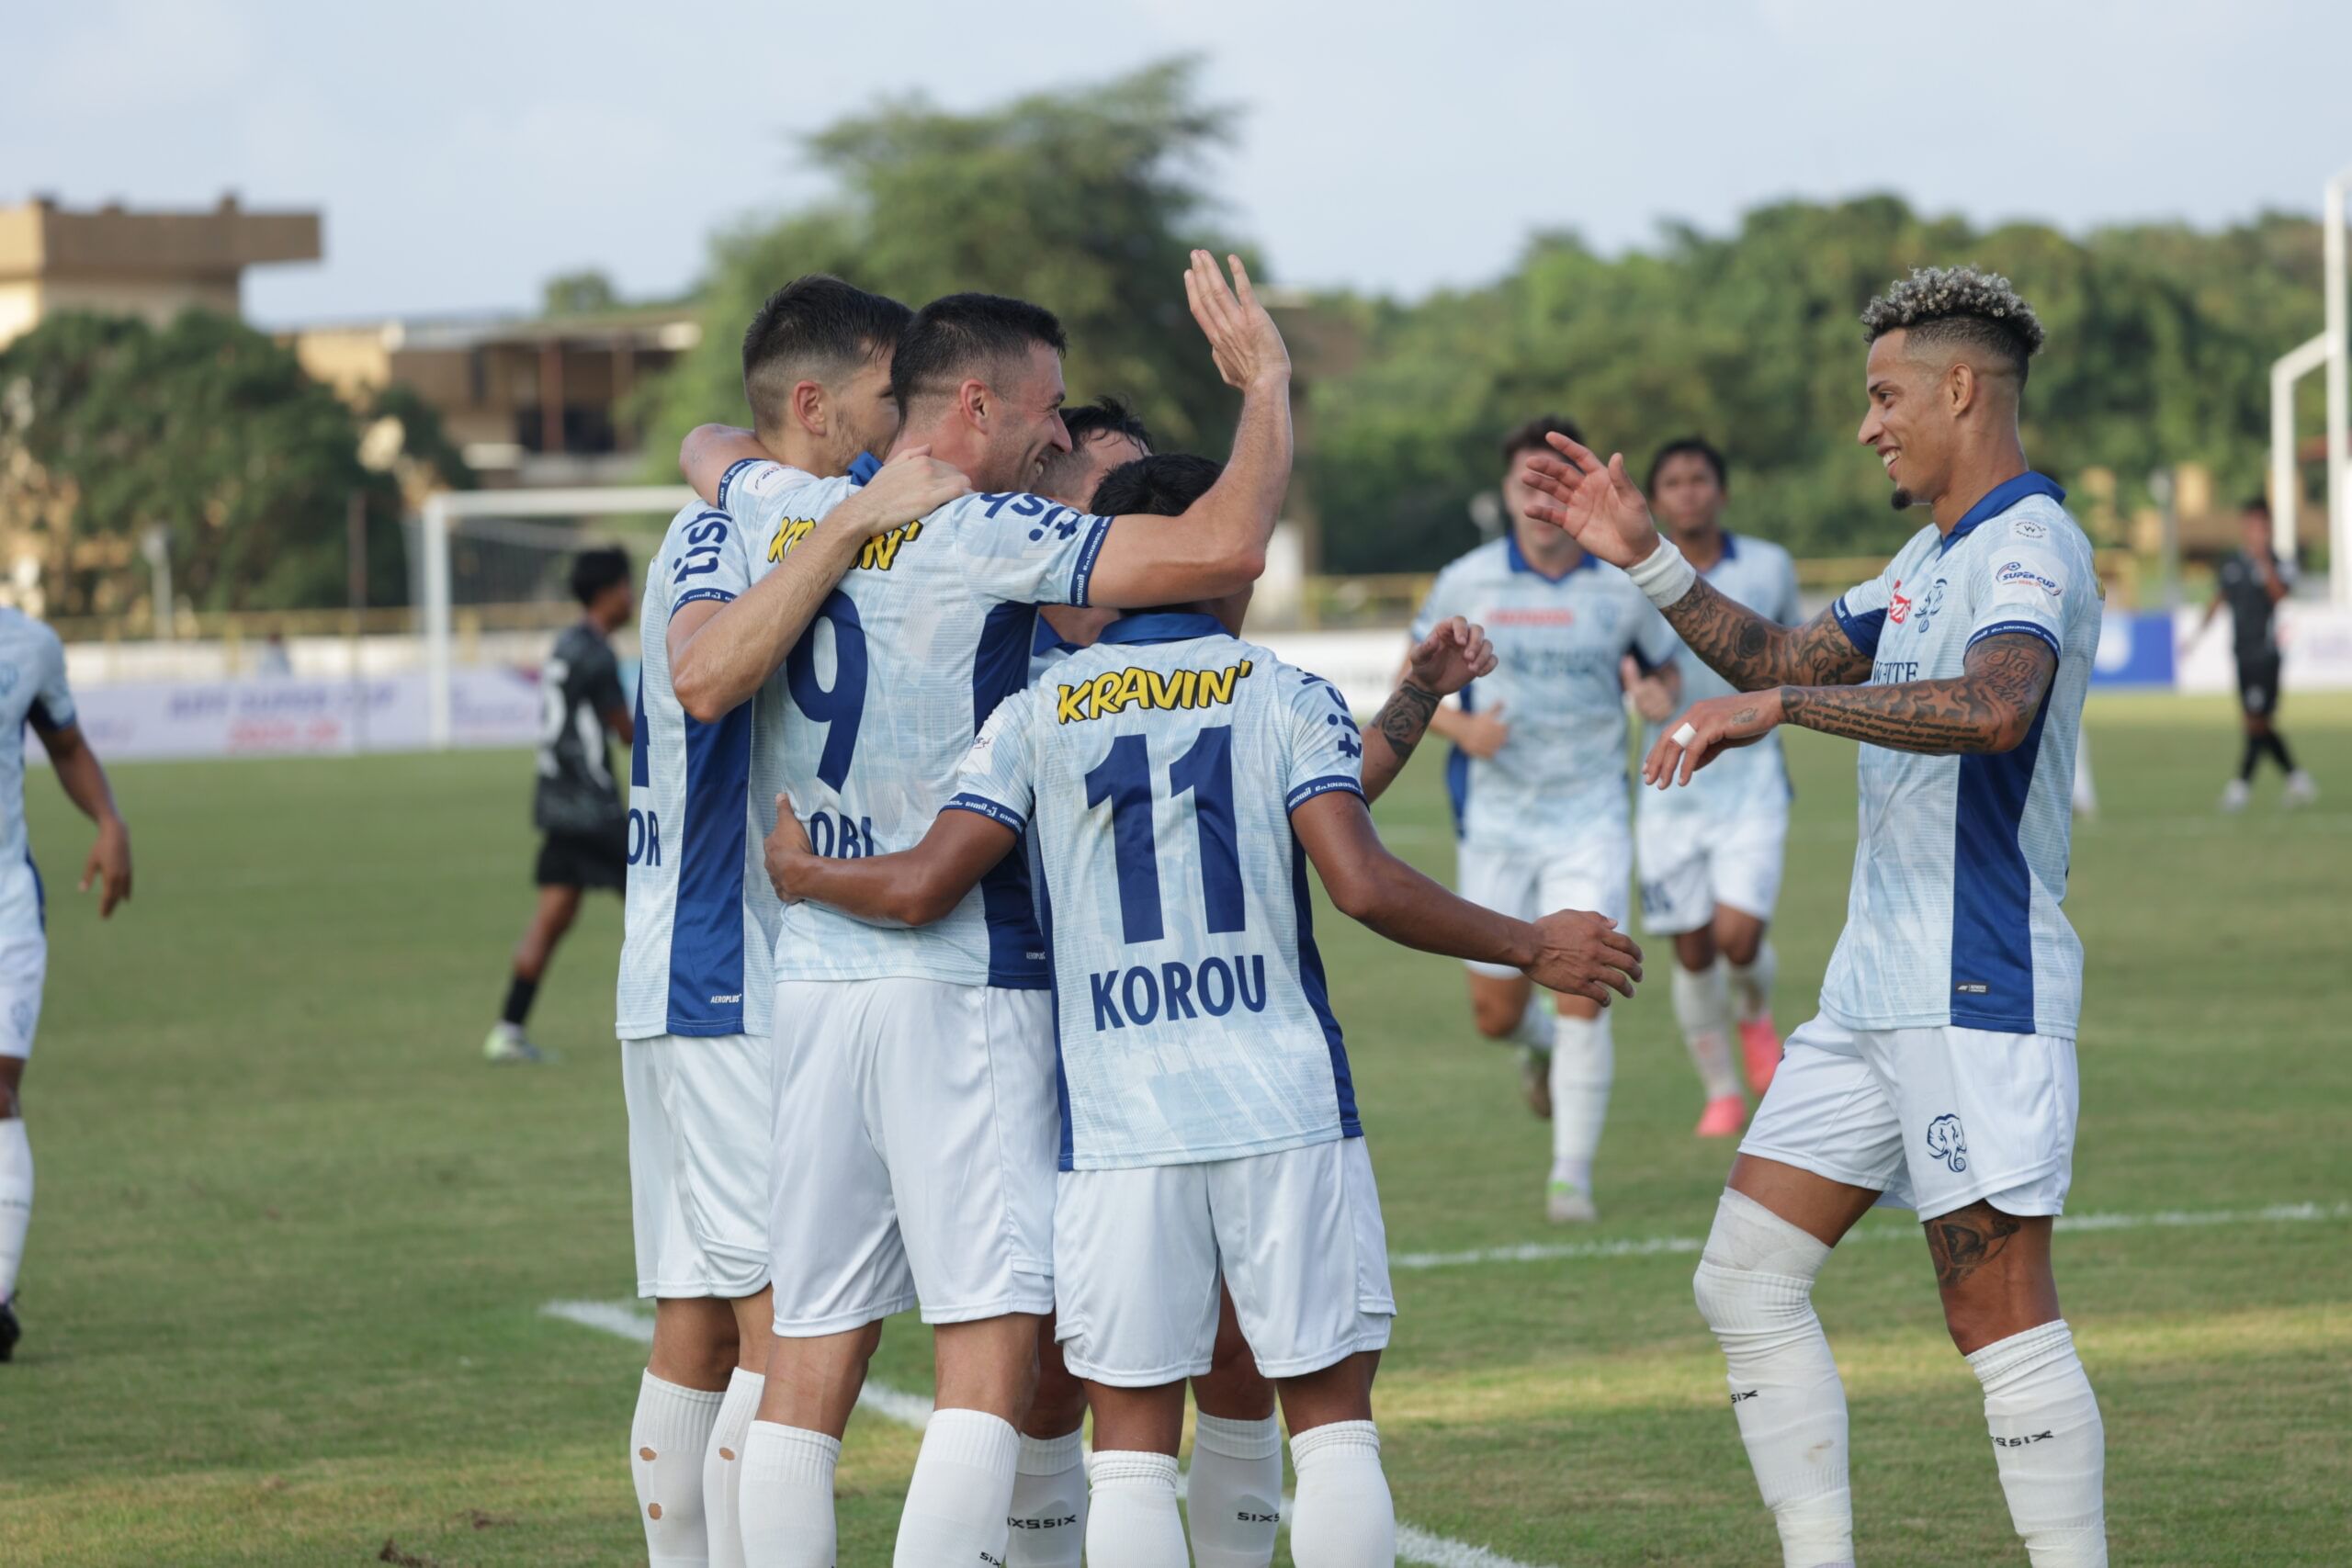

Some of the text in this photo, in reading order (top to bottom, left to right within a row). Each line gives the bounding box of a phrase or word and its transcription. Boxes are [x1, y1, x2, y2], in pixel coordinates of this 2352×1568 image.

[2003, 571, 2056, 588] SUPER CUP
[786, 588, 868, 794] 9
[1057, 659, 1253, 725] KRAVIN'
[1084, 725, 1245, 943] 11
[1091, 954, 1266, 1032] KOROU
